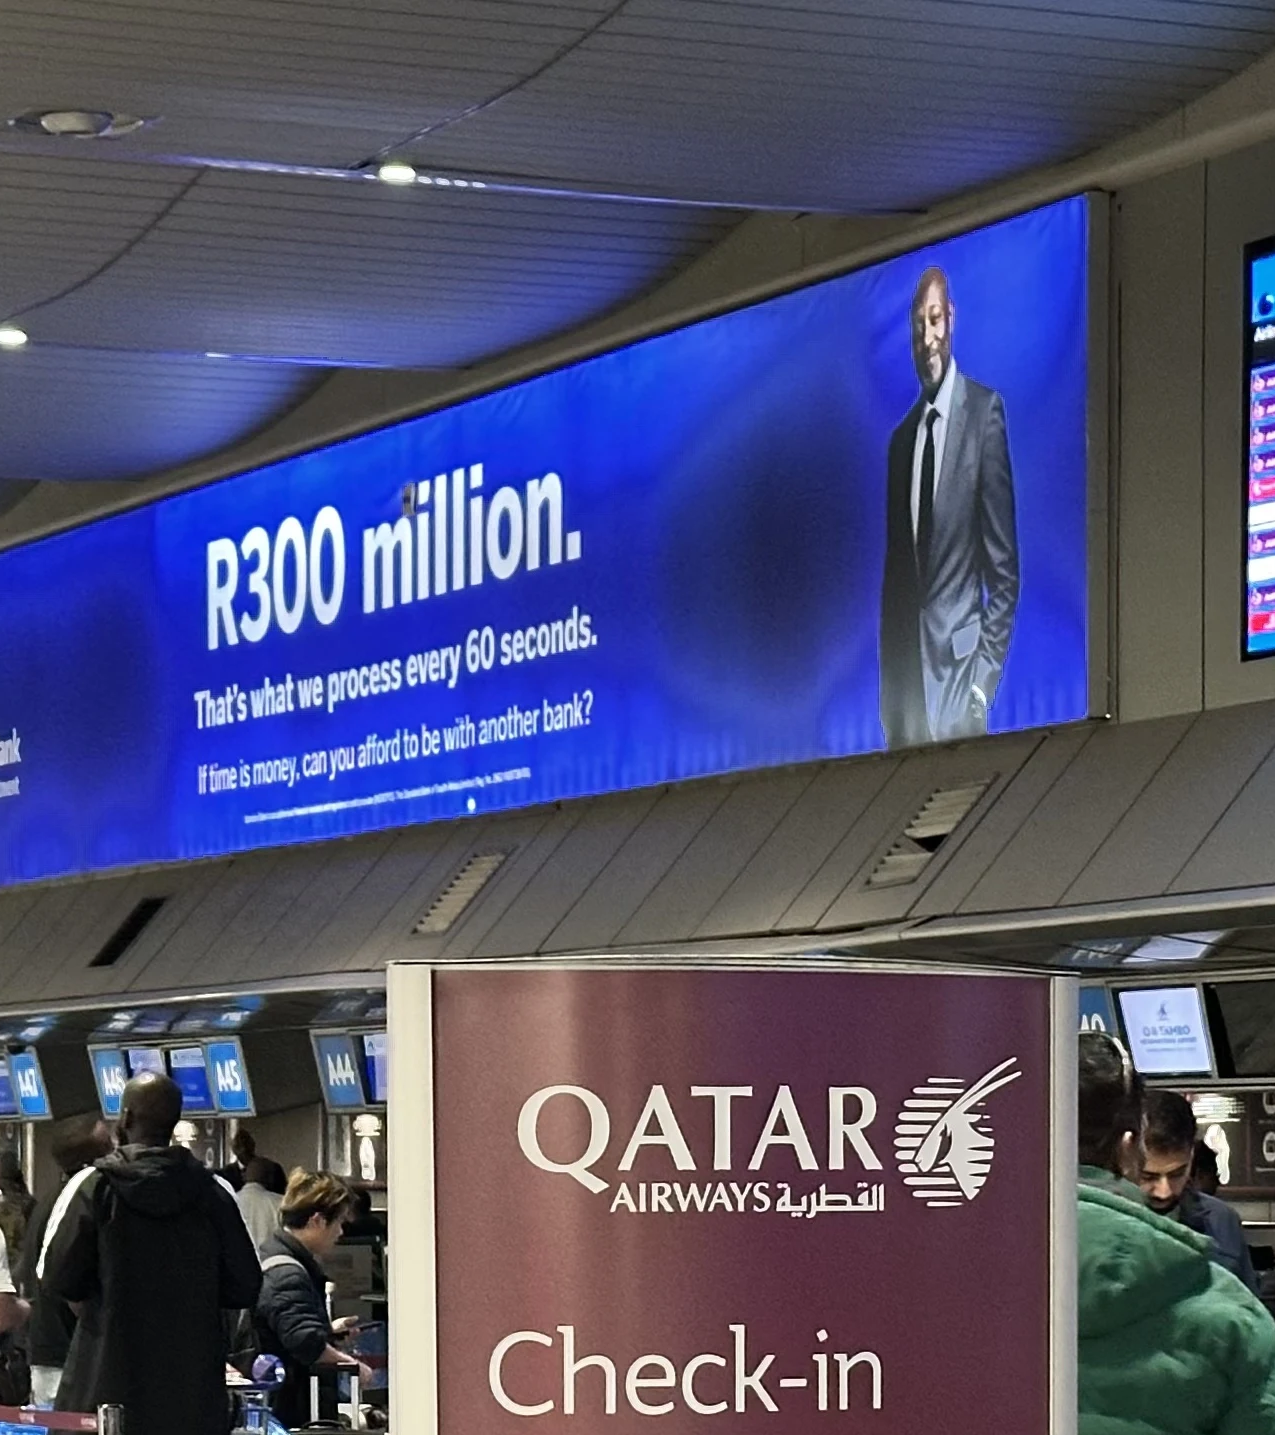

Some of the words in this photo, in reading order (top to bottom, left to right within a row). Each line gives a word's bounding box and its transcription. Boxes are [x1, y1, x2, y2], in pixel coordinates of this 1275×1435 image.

[207, 505, 346, 650] R300
[363, 462, 582, 614] million.
[194, 680, 247, 729] That's
[249, 674, 294, 719] what
[298, 675, 324, 710] we
[328, 657, 402, 713] process
[405, 644, 461, 688] every
[466, 626, 495, 674] 60
[500, 605, 598, 666] seconds.
[198, 763, 208, 795] If
[210, 761, 238, 793] time
[239, 759, 251, 787] is
[303, 750, 328, 777] can
[329, 745, 355, 780] you
[358, 728, 402, 768] afford
[404, 731, 420, 759] to
[422, 722, 441, 757] be
[444, 714, 476, 749] with
[479, 704, 540, 745] another
[543, 689, 594, 733] bank?
[216, 1059, 243, 1093] A45
[327, 1052, 356, 1087] A44
[516, 1083, 885, 1196] QATAR
[609, 1181, 771, 1214] AIRWAYS
[775, 1182, 886, 1219] القطرية
[488, 1323, 885, 1418] Check-in
